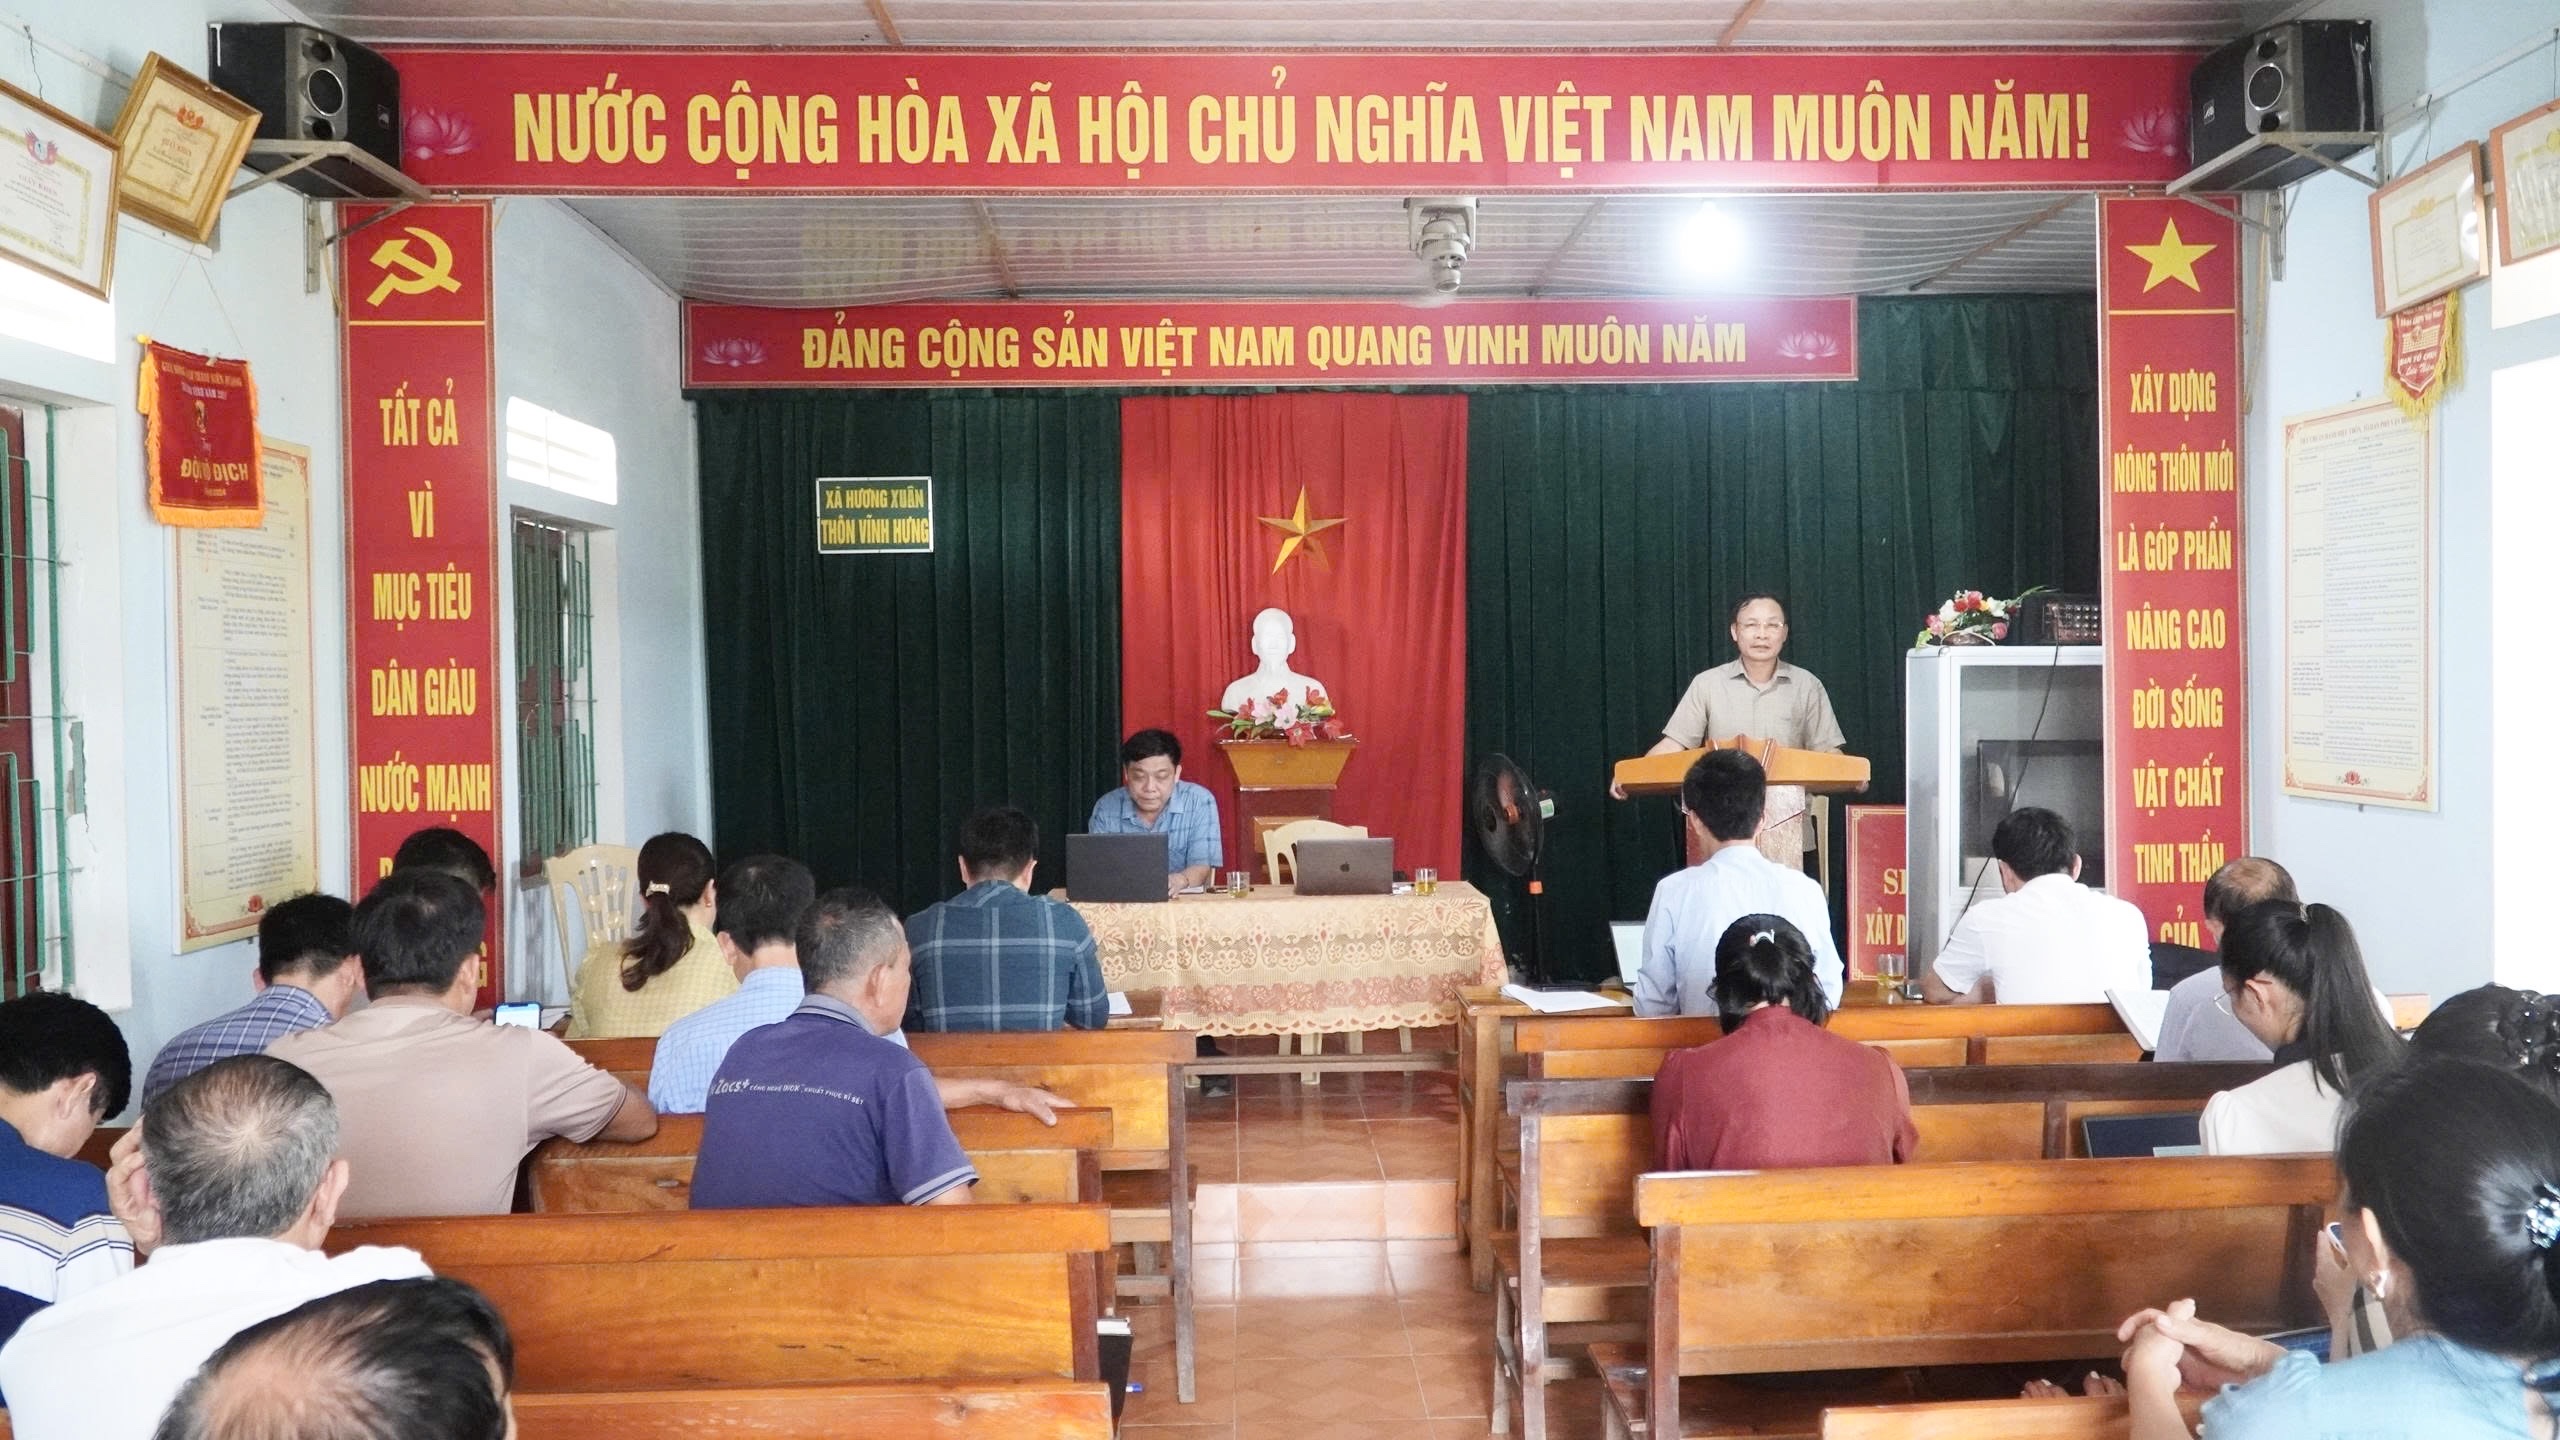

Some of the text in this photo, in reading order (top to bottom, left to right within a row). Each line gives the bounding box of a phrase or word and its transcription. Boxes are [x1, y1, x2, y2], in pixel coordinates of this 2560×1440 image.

[513, 65, 2089, 180] NƯỚC CỘNG HÒA XÃ HỘI CHỦ NGHĨA VIỆT NAM MUÔN NĂM!
[801, 309, 1746, 378] ĐẢNG CỘNG SẢN VIỆT NAM QUANG VINH MUÔN NĂM
[379, 377, 459, 447] TẤT CẢ
[2130, 364, 2217, 422] XÂY DỰNG
[2113, 443, 2157, 493] NÔNG
[2160, 443, 2201, 493] THÔN
[2204, 439, 2234, 492] MỚI
[408, 480, 434, 538] VÌ
[821, 514, 929, 545] THÔN VĨNH HƯNG
[2117, 515, 2232, 572] LÀ GÓP PHẦN
[373, 562, 472, 631] MỤC TIÊU
[2126, 601, 2226, 651] NÂNG CAO
[371, 657, 476, 716] DÂN GIÀU
[2132, 673, 2223, 729] ĐỜI SỐNG
[360, 750, 420, 813] NƯỚC
[426, 764, 491, 822] MẠNH
[2132, 752, 2224, 817] VẬT CHẤT
[2133, 843, 2175, 884] TINH
[1864, 906, 1893, 946] XÂY
